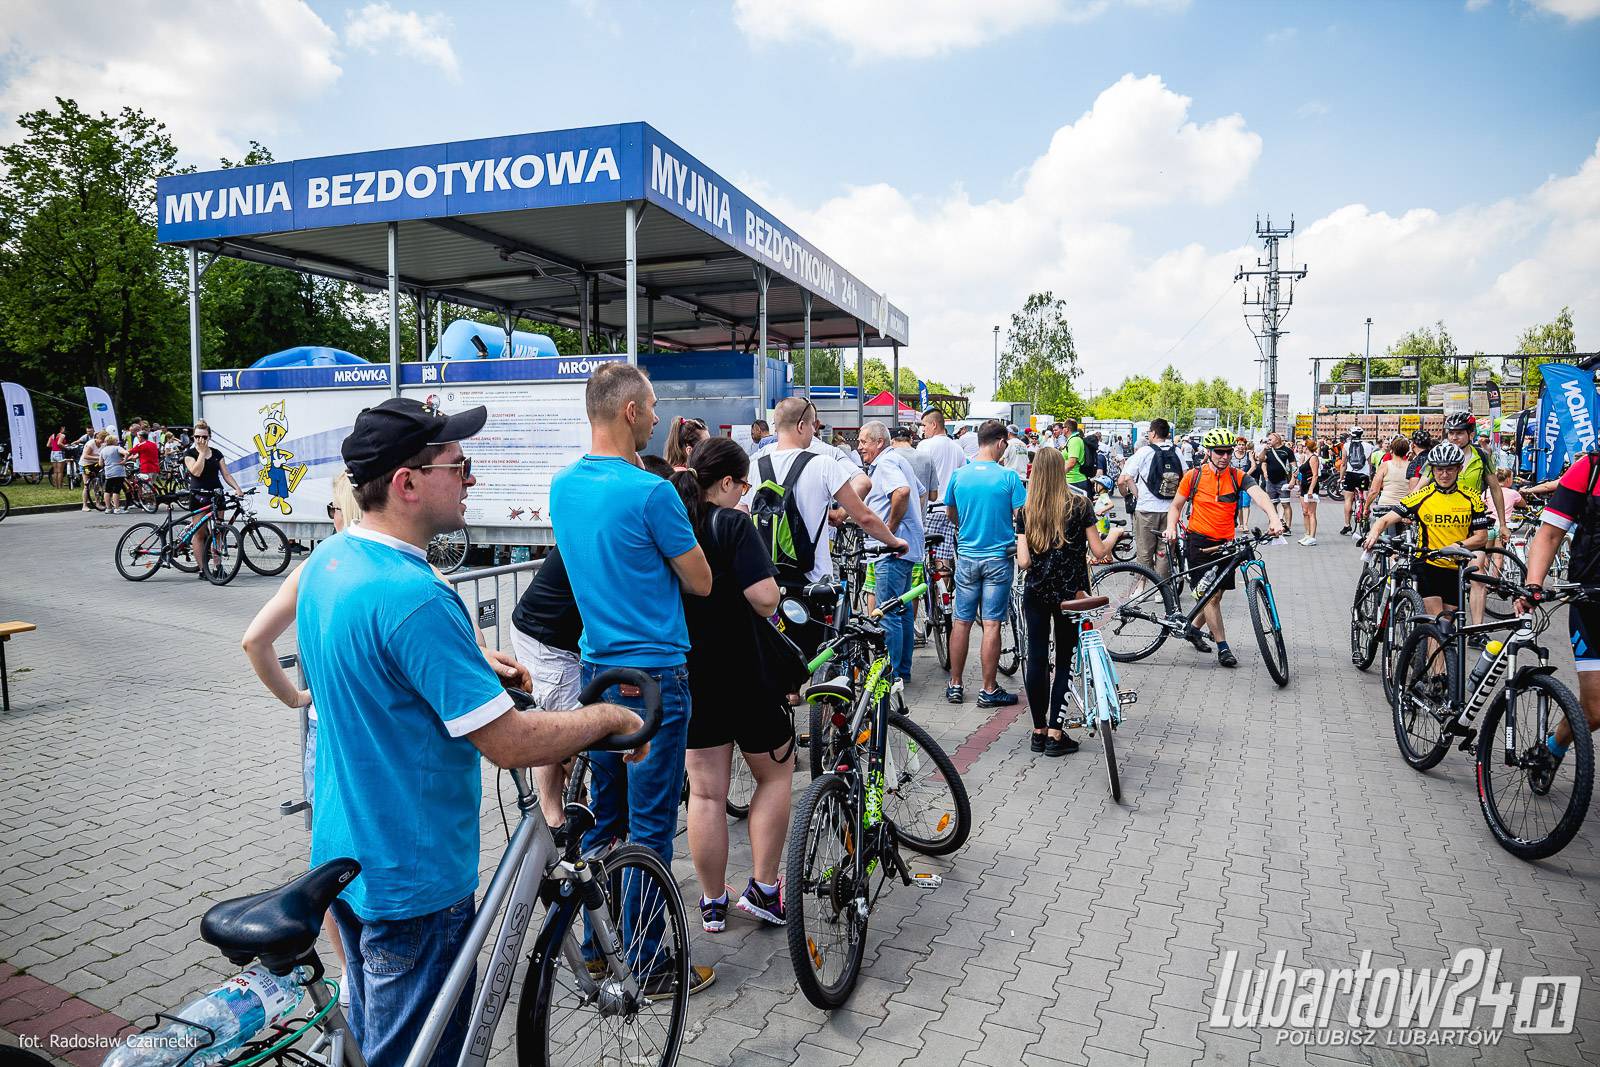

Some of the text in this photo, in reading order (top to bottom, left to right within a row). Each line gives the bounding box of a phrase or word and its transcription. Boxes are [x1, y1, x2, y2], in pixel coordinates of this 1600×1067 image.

[164, 146, 621, 225] MYJNIA BEZDOTYKOWA
[651, 144, 733, 235] MYJNIA
[745, 208, 836, 297] BEZDOTYKOWA
[334, 367, 388, 382] MRÓWKA
[558, 358, 619, 374] MRÓW
